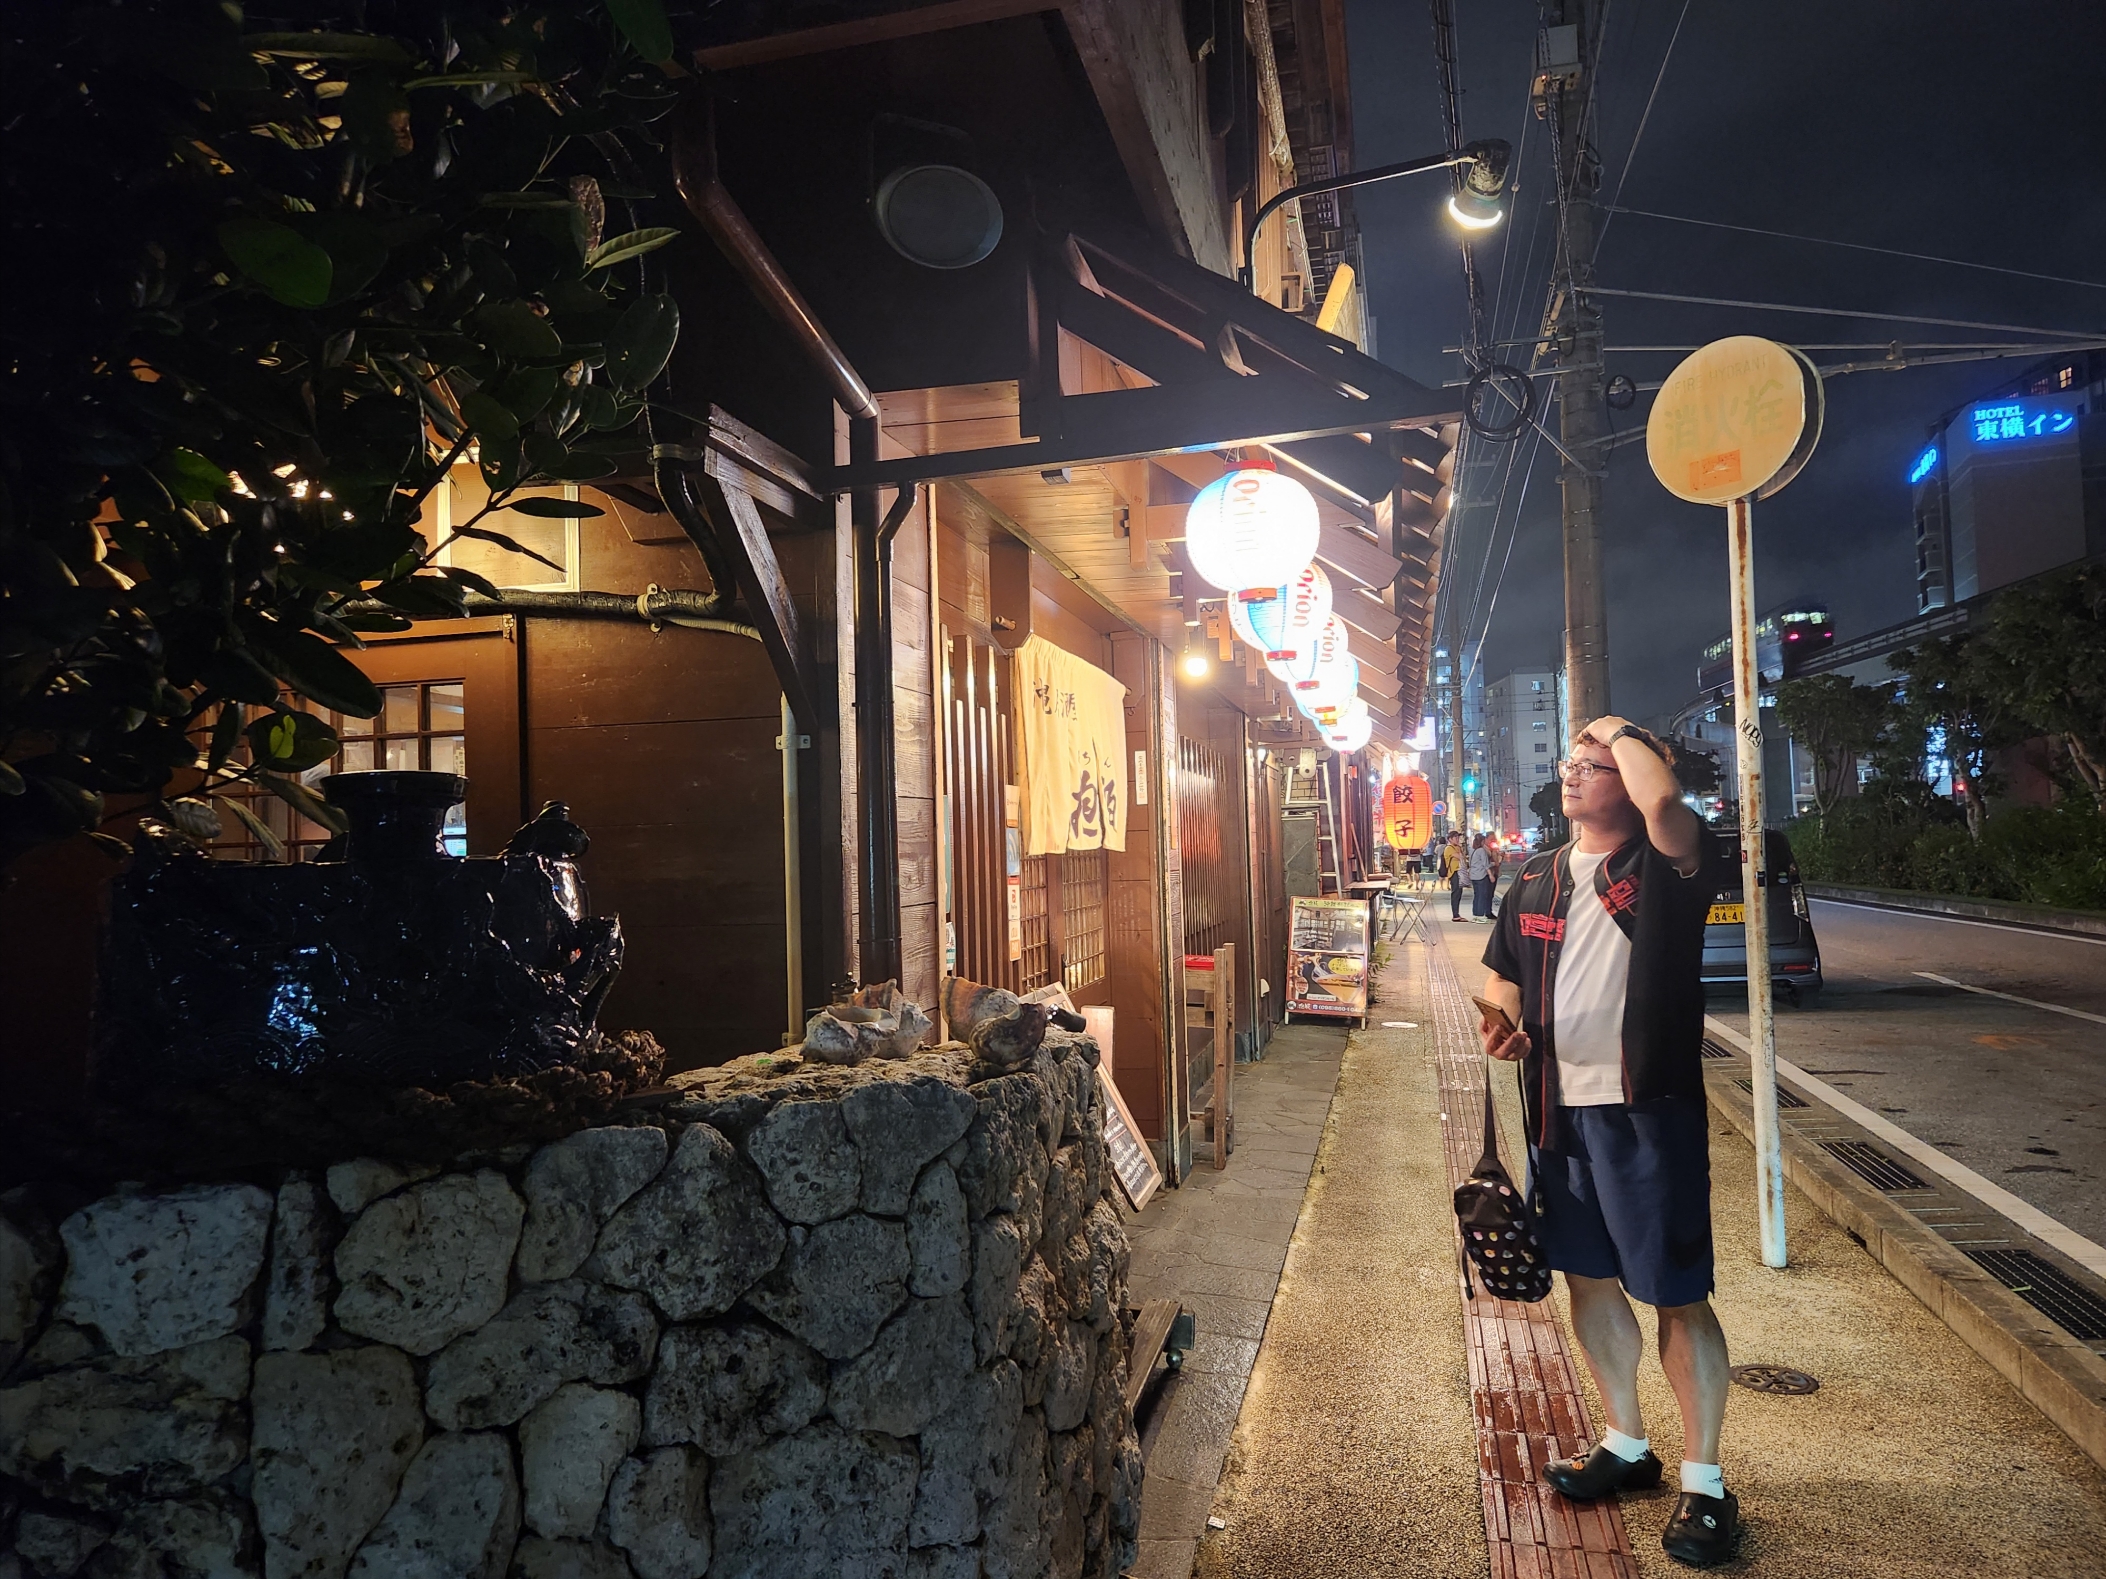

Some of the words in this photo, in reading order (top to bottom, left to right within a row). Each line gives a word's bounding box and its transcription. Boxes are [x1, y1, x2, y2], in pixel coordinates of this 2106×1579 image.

[1709, 354, 1768, 381] HYDRANT
[1664, 379, 1783, 455] 消火栓
[1974, 405, 2024, 421] HOTEL
[1975, 413, 2073, 441] 東横イン
[1392, 784, 1413, 838] 餃子
[1714, 911, 1744, 922] 84-41
